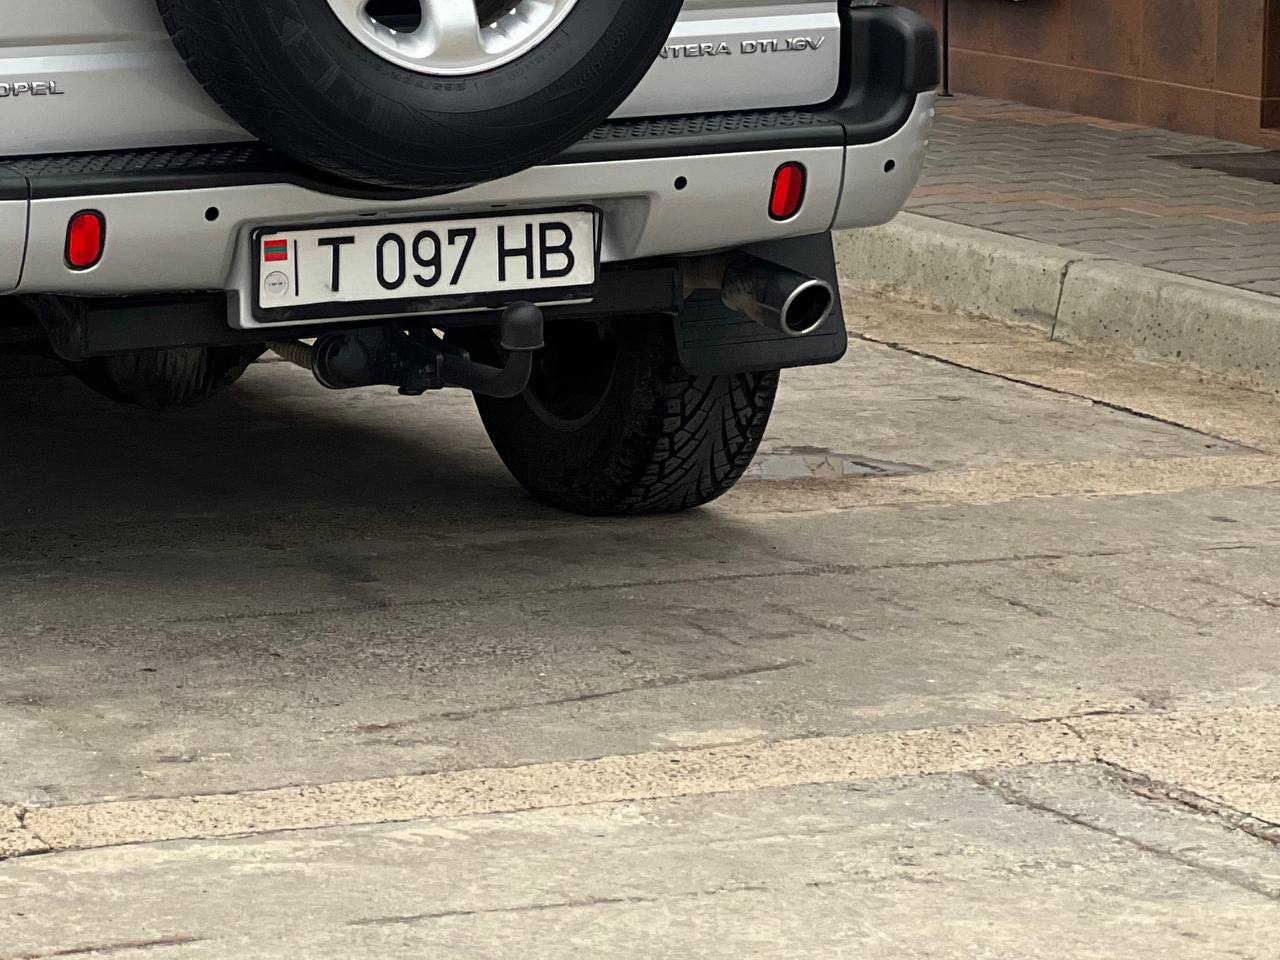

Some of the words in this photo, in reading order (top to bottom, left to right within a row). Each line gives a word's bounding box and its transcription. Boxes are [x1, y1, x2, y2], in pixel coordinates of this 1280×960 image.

[658, 41, 732, 58] NTERA
[317, 235, 355, 293] T
[375, 228, 476, 290] 097
[497, 221, 575, 282] HB
